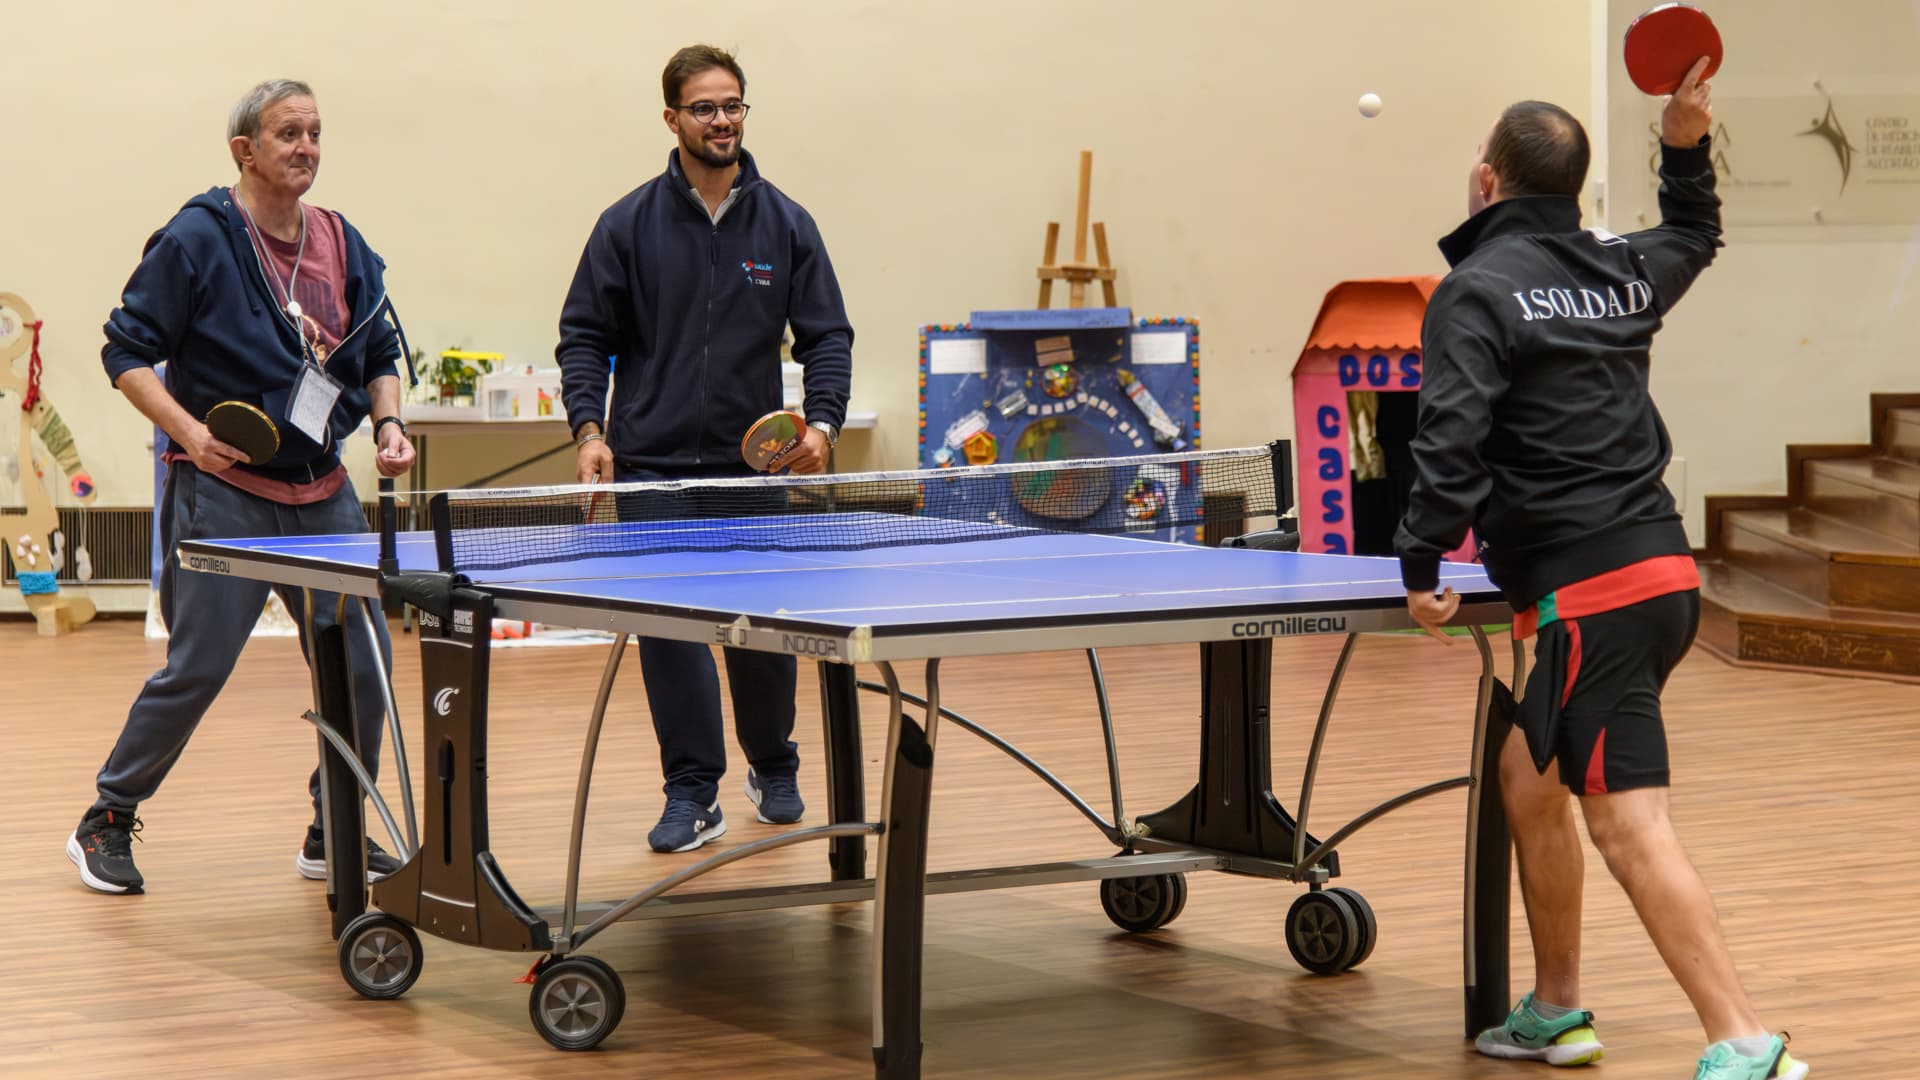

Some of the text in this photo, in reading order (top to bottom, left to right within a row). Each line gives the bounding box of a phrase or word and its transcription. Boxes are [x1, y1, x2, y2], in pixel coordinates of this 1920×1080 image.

[1512, 279, 1653, 321] J.SOLDAD
[1338, 353, 1421, 387] DOS
[1232, 617, 1346, 637] cornilleau
[782, 633, 837, 656] INDOOR
